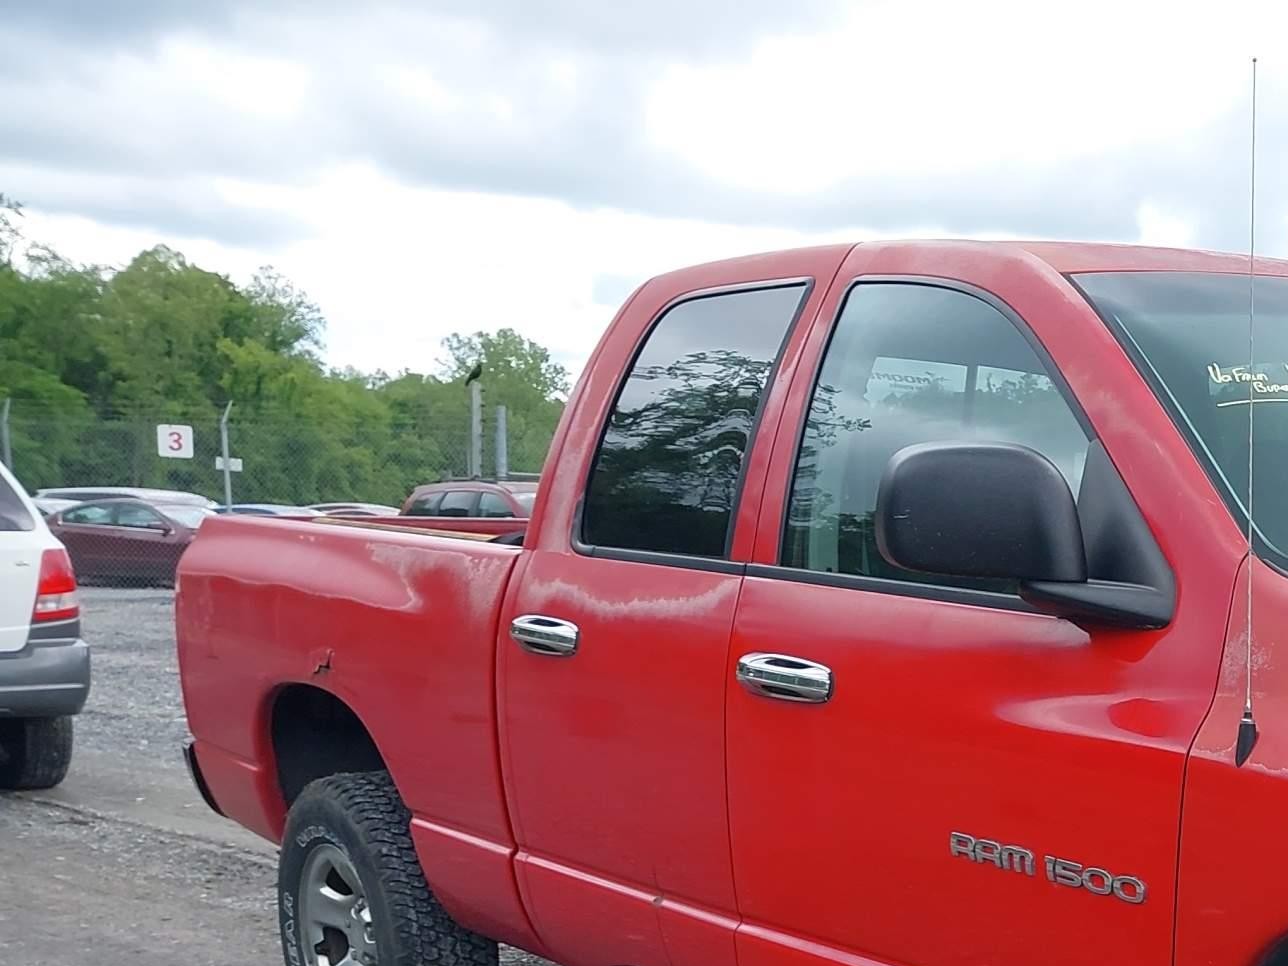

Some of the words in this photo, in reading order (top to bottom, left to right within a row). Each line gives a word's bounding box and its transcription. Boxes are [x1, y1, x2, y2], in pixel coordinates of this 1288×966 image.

[168, 431, 183, 451] 3
[950, 831, 1034, 876] RAM
[1044, 855, 1145, 904] 1500
